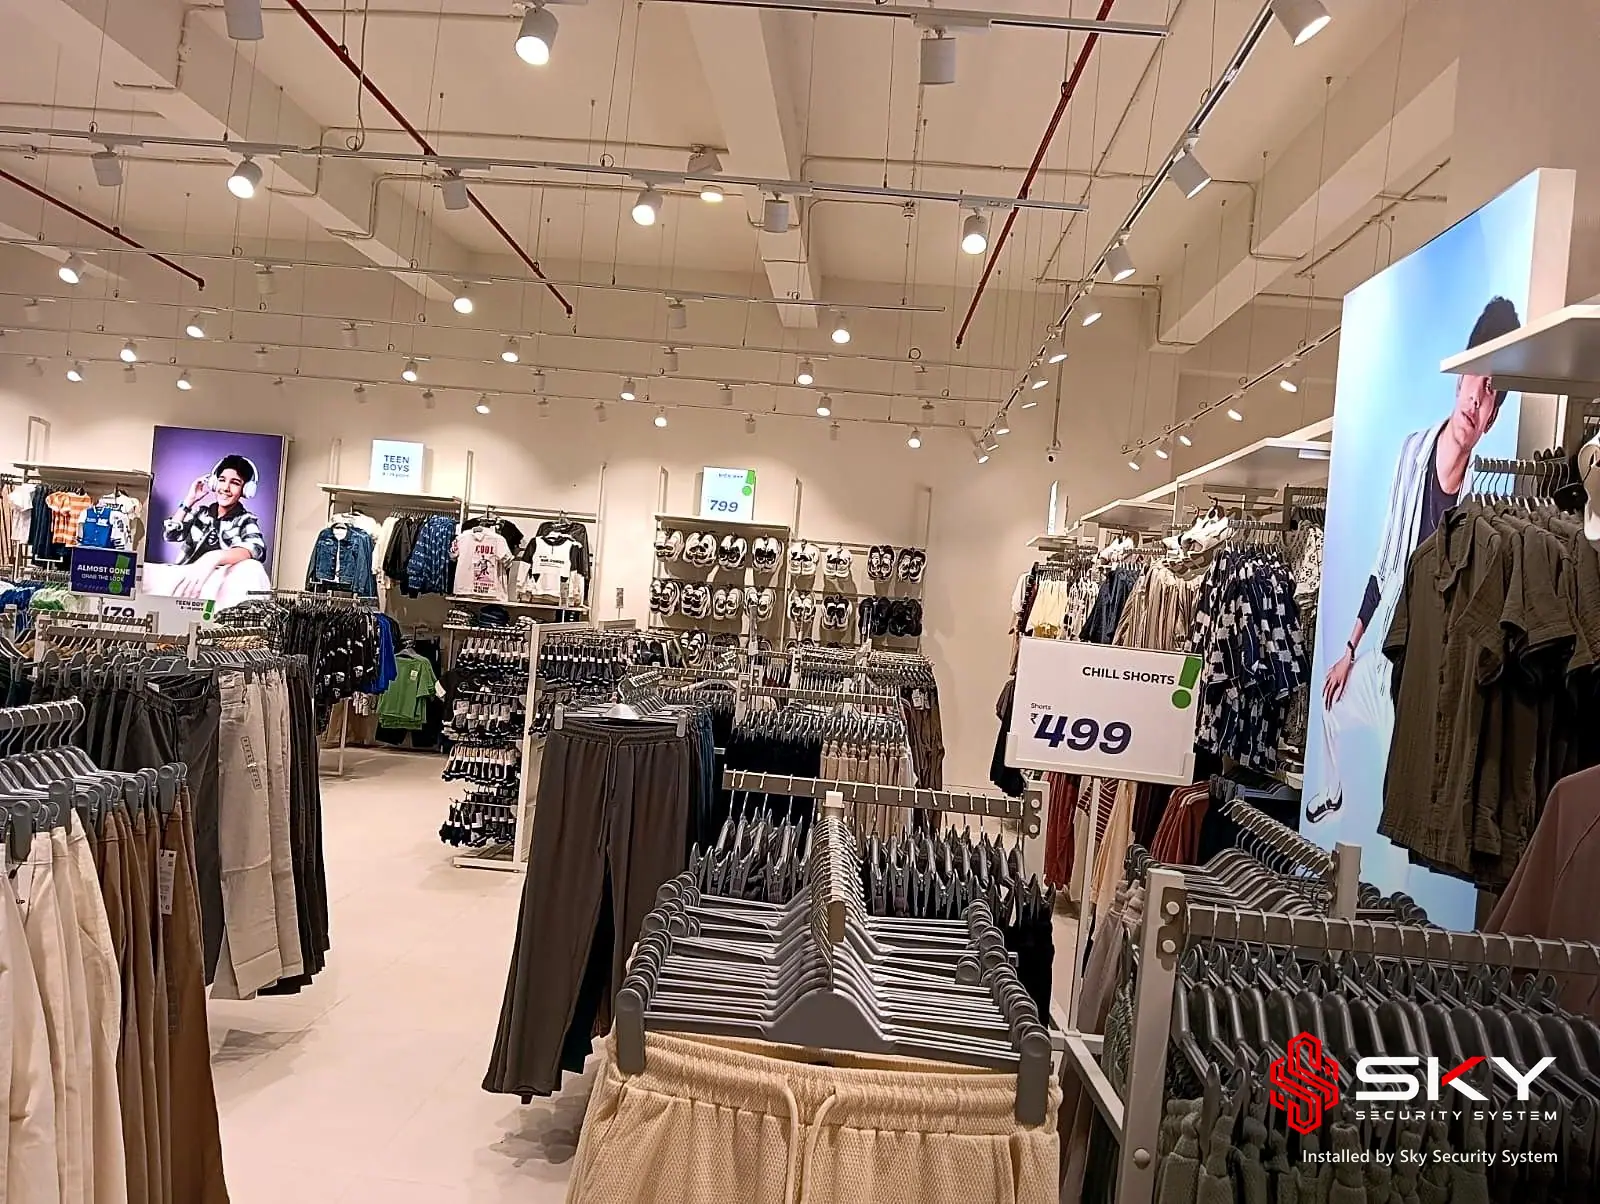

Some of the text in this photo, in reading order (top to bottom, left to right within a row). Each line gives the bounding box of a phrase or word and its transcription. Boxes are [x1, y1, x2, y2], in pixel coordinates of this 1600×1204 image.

[383, 454, 410, 464] TEEN
[383, 463, 410, 473] BOYS
[709, 499, 739, 512] 799
[77, 564, 131, 576] ALMOST GONE
[1082, 666, 1175, 685] CHILL SHORTS
[1030, 702, 1052, 710] Shorts
